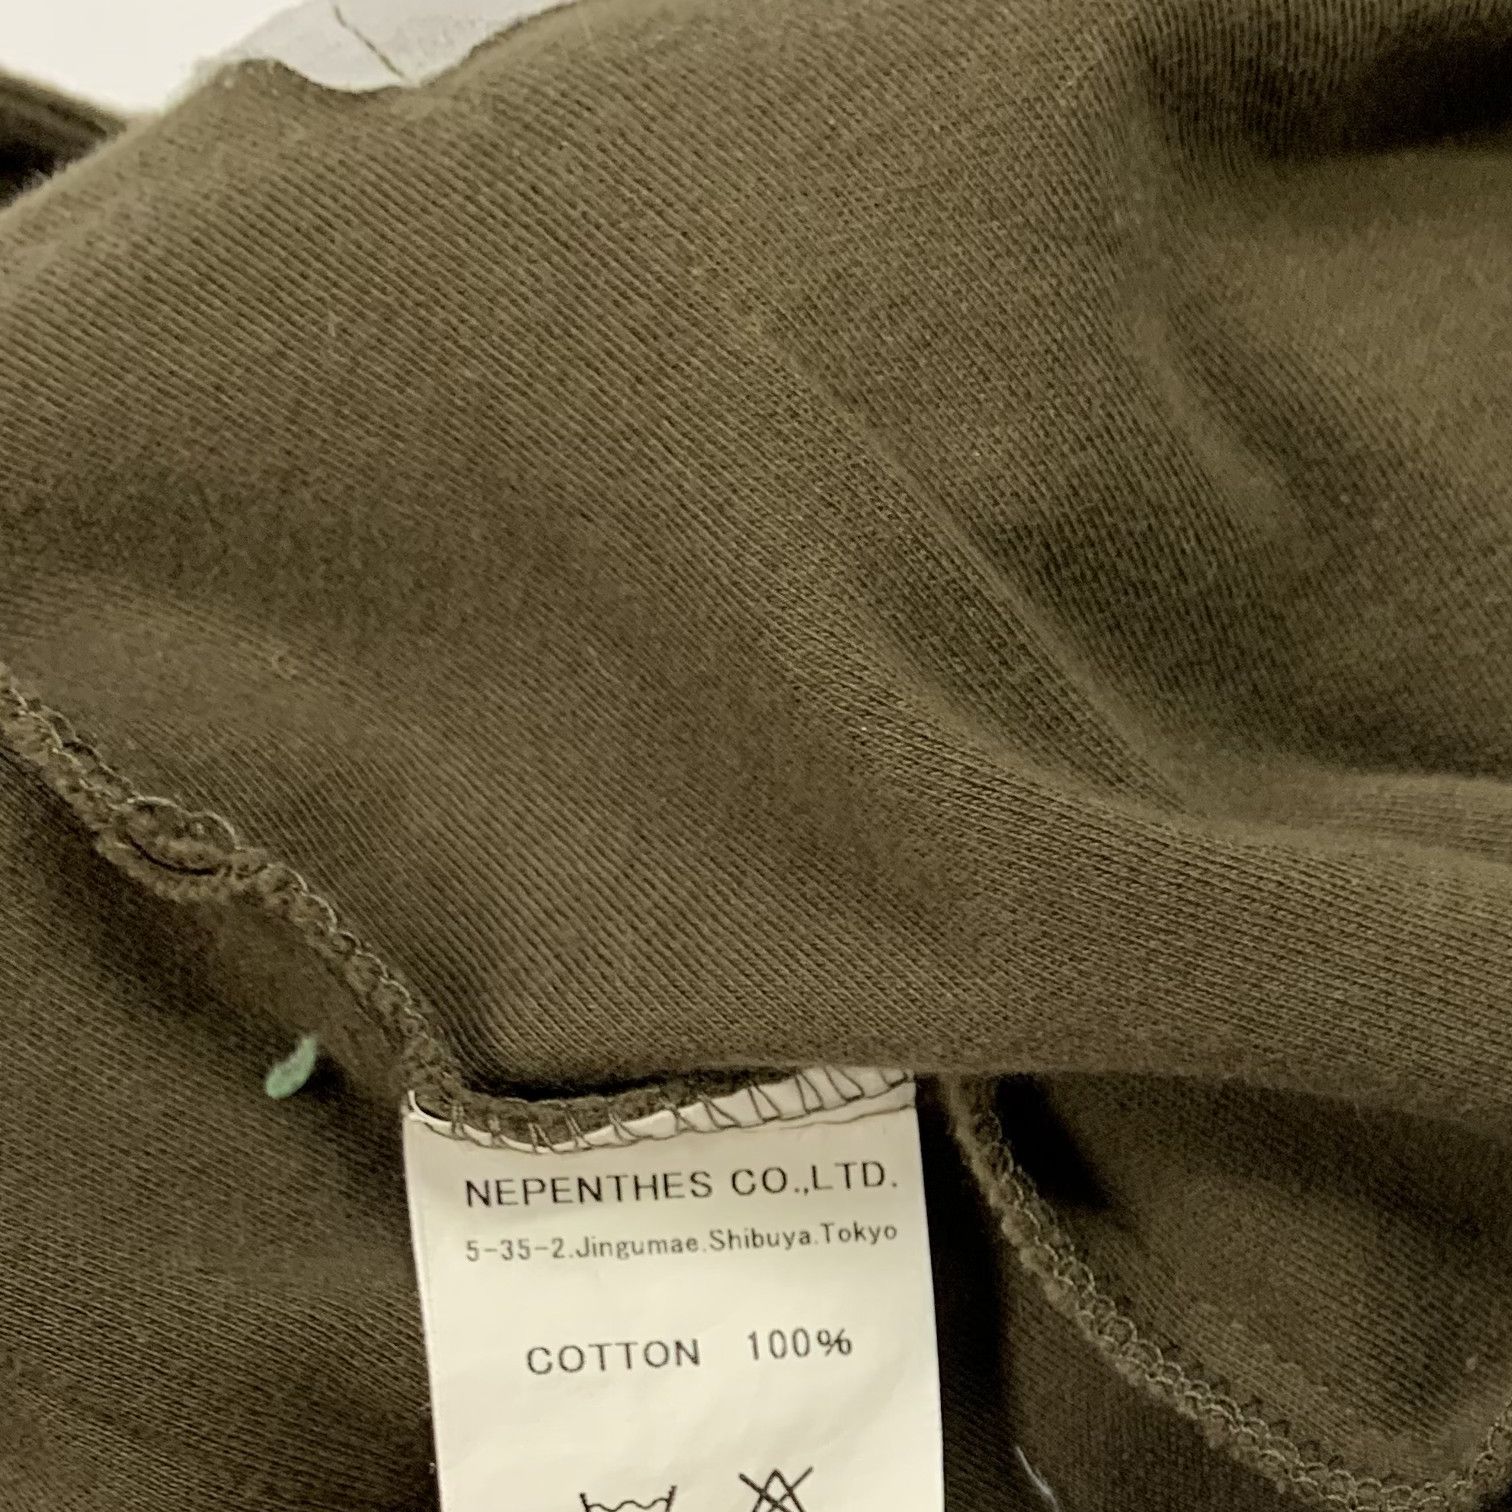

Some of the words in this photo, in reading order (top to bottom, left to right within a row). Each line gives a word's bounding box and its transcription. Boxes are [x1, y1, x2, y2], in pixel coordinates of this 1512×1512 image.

[465, 1170, 714, 1208] NEPENTHES
[730, 1160, 899, 1198] CO.,LTD.
[526, 1338, 701, 1376] COTTON
[746, 1328, 853, 1361] 100%
